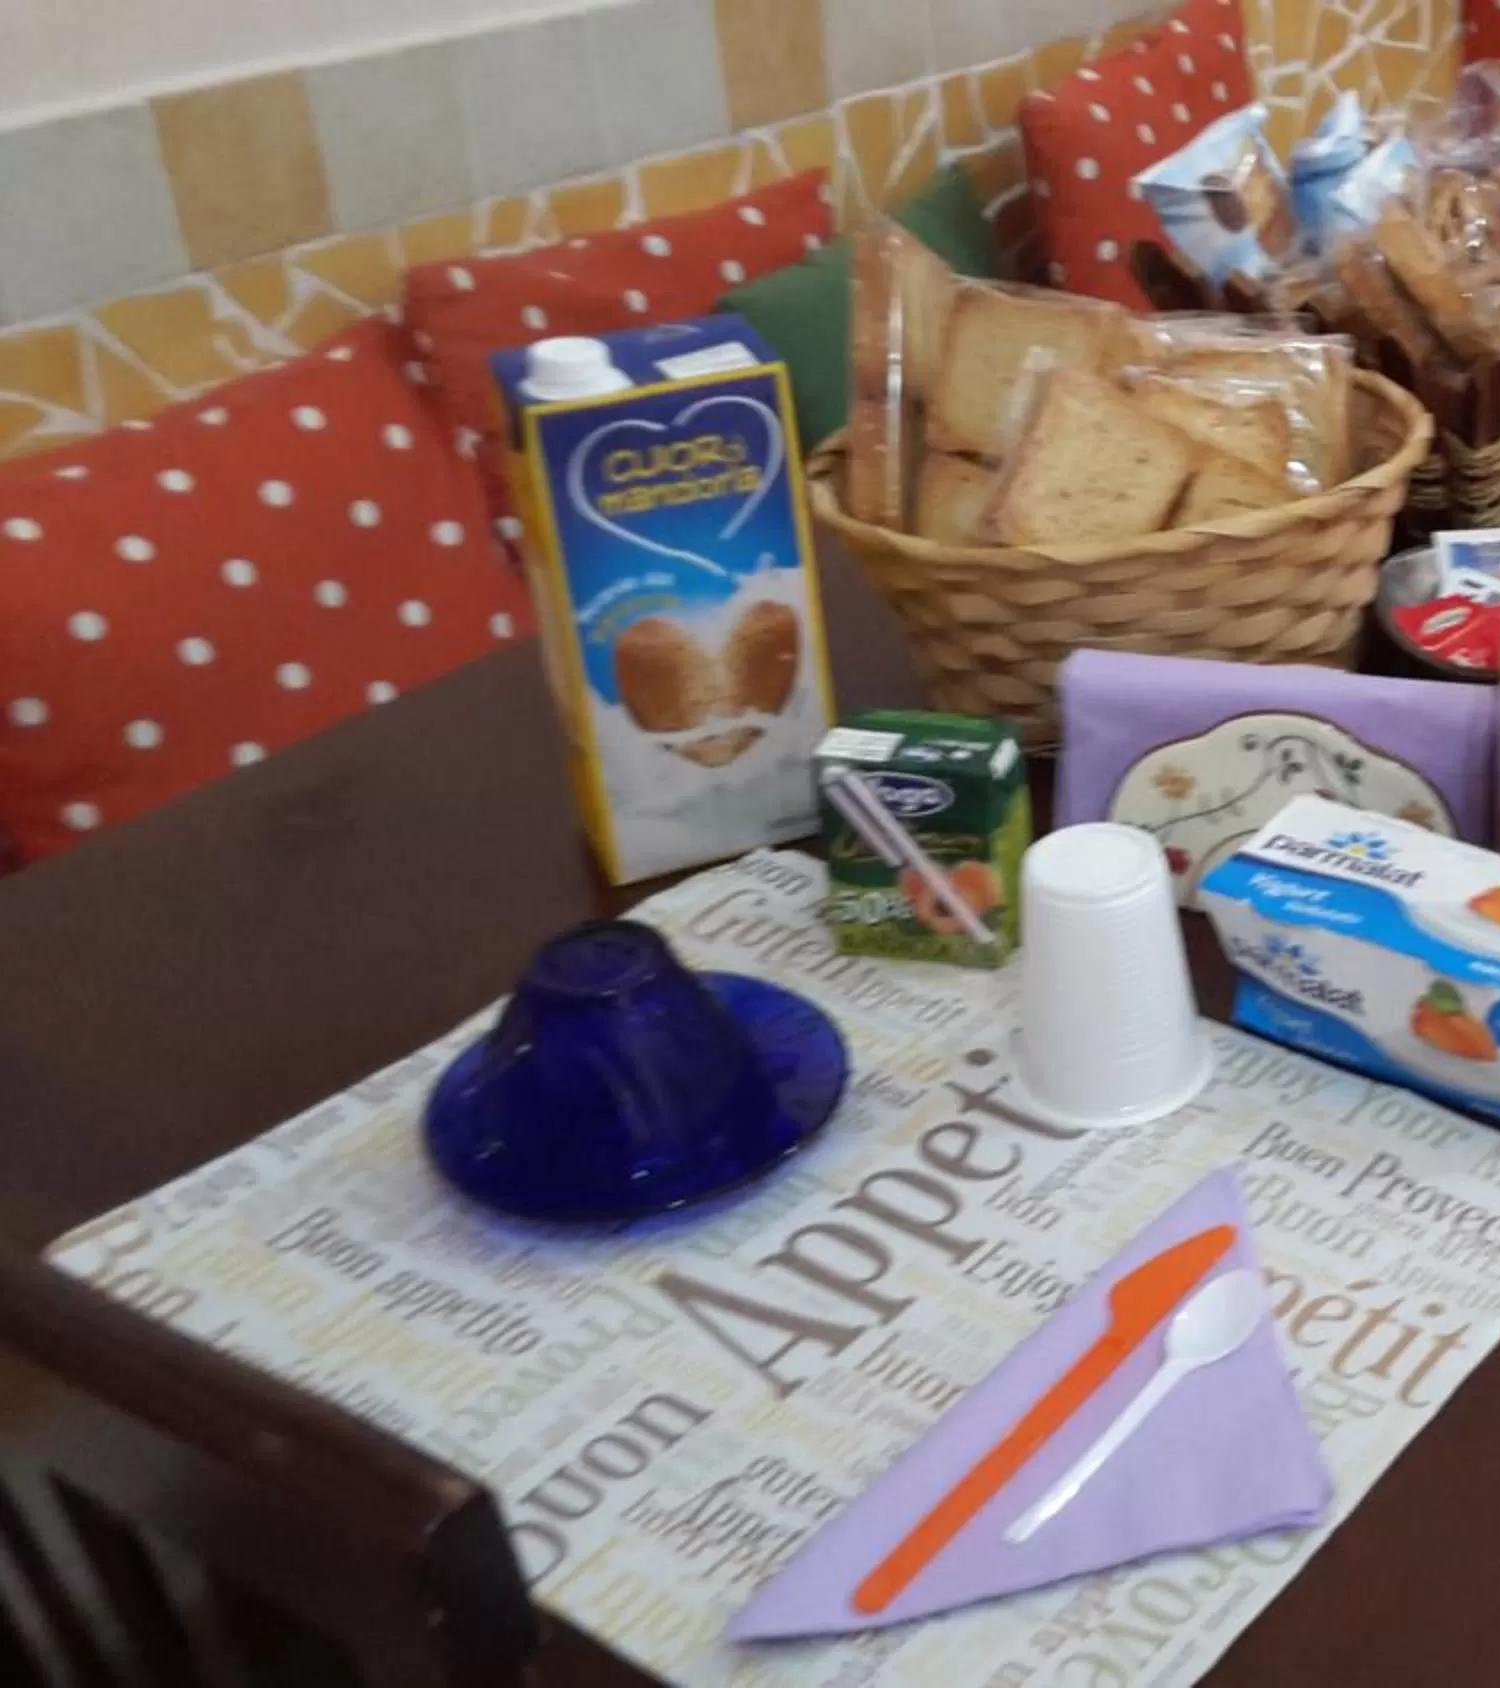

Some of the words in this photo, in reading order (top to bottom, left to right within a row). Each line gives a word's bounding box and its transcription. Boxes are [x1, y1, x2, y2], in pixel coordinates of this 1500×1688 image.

[1259, 832, 1427, 889] parmalat
[1241, 1119, 1347, 1182] Buen
[1336, 1080, 1474, 1151] Your
[650, 1048, 1095, 1400] Appet
[264, 1206, 382, 1283] Buon
[370, 1268, 545, 1355] appetito
